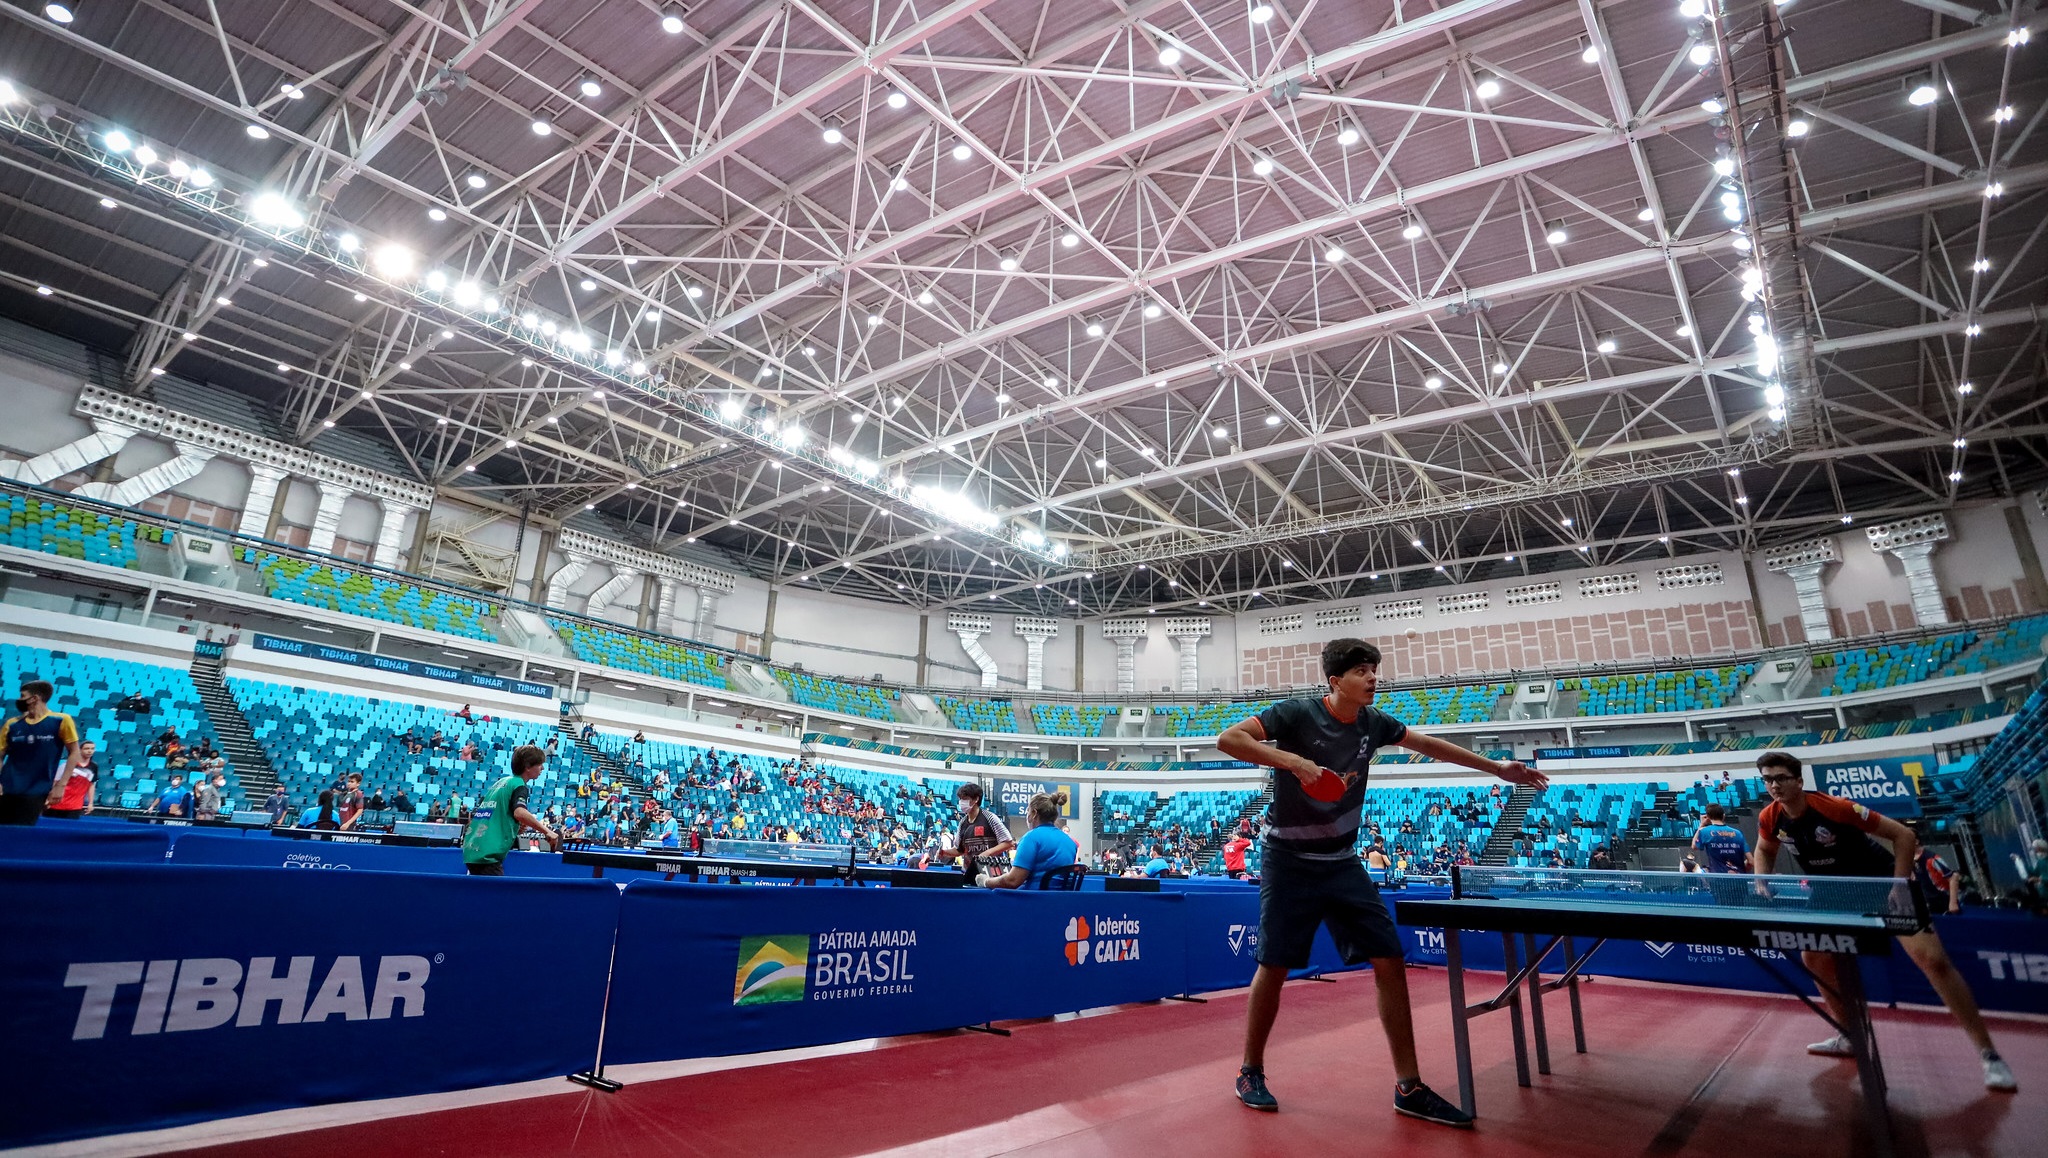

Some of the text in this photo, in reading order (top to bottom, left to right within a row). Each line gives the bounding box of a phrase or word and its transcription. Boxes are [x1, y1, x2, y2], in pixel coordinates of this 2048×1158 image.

[262, 637, 303, 652] TIBHAR
[319, 648, 358, 663] TIBHAR
[374, 657, 409, 672] TIBHAR
[424, 666, 458, 680] TIBHAR
[471, 675, 504, 688] TIBHAR
[516, 683, 547, 696] TIBHAR
[1543, 749, 1575, 758] TIBHAR
[1588, 747, 1621, 756] TIBHAR
[1825, 764, 1888, 785] ARENA
[1001, 781, 1047, 794] ARENA
[1827, 780, 1911, 800] CARIOCA
[1001, 793, 1030, 804] CARI
[331, 835, 360, 843] TIBHAR
[286, 853, 321, 863] coletivo
[656, 862, 681, 874] TIBHAR
[697, 865, 757, 877] TIBHAR SMASH 28
[1094, 912, 1140, 937] loterias
[818, 927, 918, 950] PÁTRIA AMADA
[1751, 929, 1859, 954] TIBHAR
[1094, 938, 1140, 964] CAIXA
[1421, 947, 1430, 955] by
[1727, 946, 1746, 957] DE
[1687, 954, 1726, 963] by CBTM
[814, 949, 914, 987] BRASIL
[813, 984, 914, 1001] GOVERNO FEDERAL
